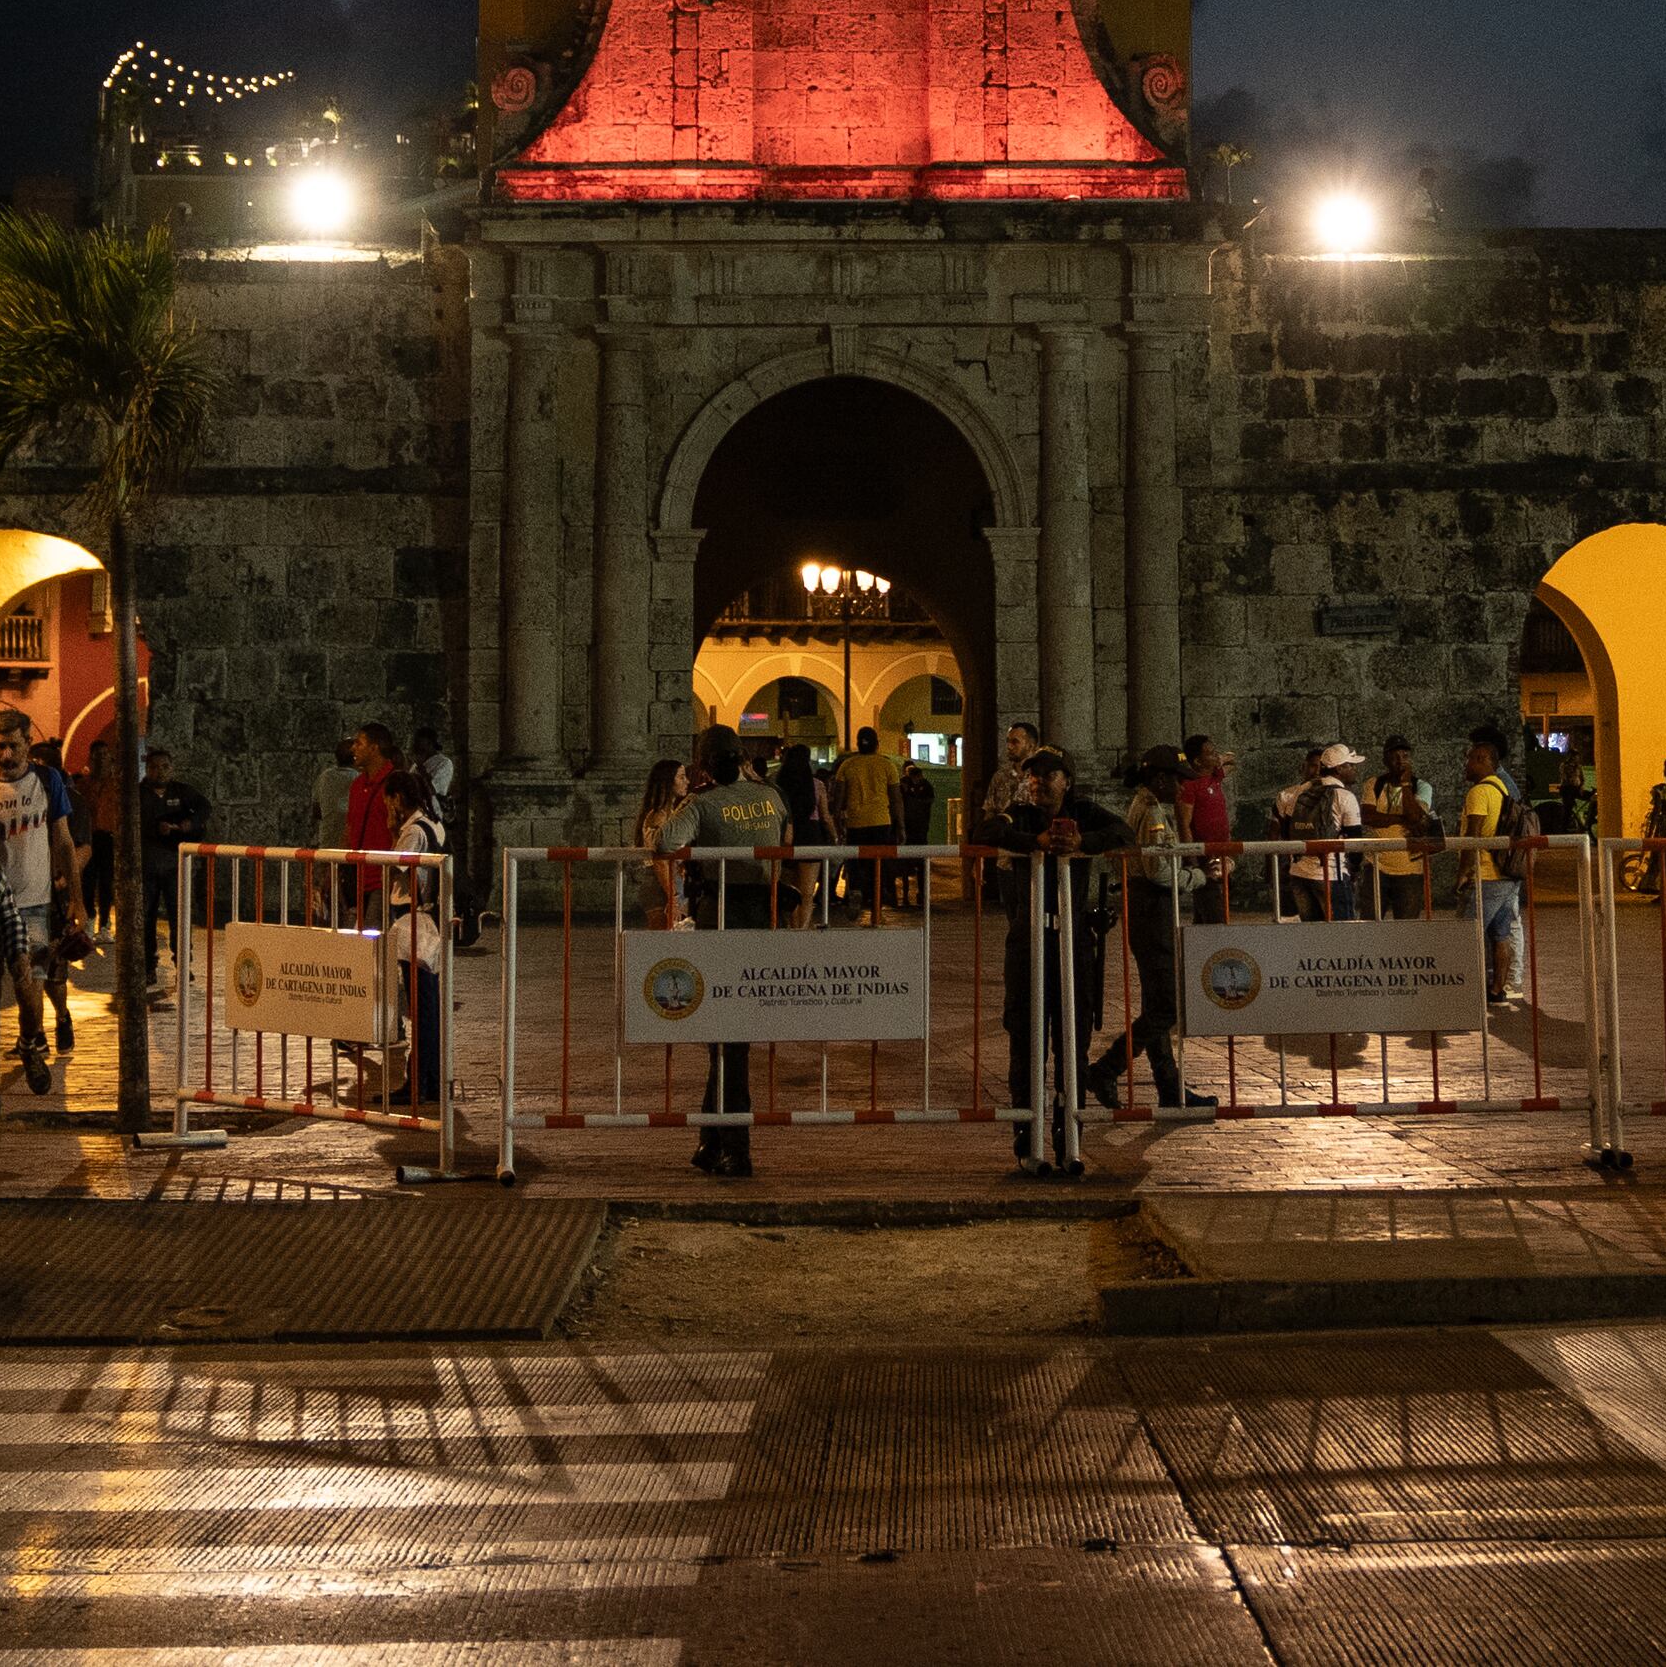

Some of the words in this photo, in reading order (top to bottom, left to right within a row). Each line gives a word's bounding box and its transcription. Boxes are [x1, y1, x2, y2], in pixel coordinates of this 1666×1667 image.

[21, 795, 32, 807] to
[722, 800, 775, 823] POLICIA
[279, 961, 320, 978] ALCALDÍA
[322, 964, 352, 980] MAYOR
[1296, 954, 1374, 971] ALCALDÍA
[1379, 956, 1437, 970] MAYOR
[740, 963, 818, 980] ALCALDÍA
[823, 965, 880, 979] MAYOR
[265, 978, 277, 990] DE
[278, 979, 324, 994] CARTAGENA
[326, 983, 337, 995] DE
[339, 984, 367, 998] INDIAS
[1269, 977, 1290, 989] DE
[1295, 975, 1384, 988] CARTAGENA
[1388, 974, 1407, 986] DE
[1413, 973, 1465, 985] INDIAS
[712, 986, 734, 999] DE
[738, 984, 828, 997] CARTAGENA
[832, 984, 852, 995] DE
[857, 982, 910, 995] INDIAS
[759, 998, 787, 1007] Distrito
[831, 997, 863, 1006] Cultural
